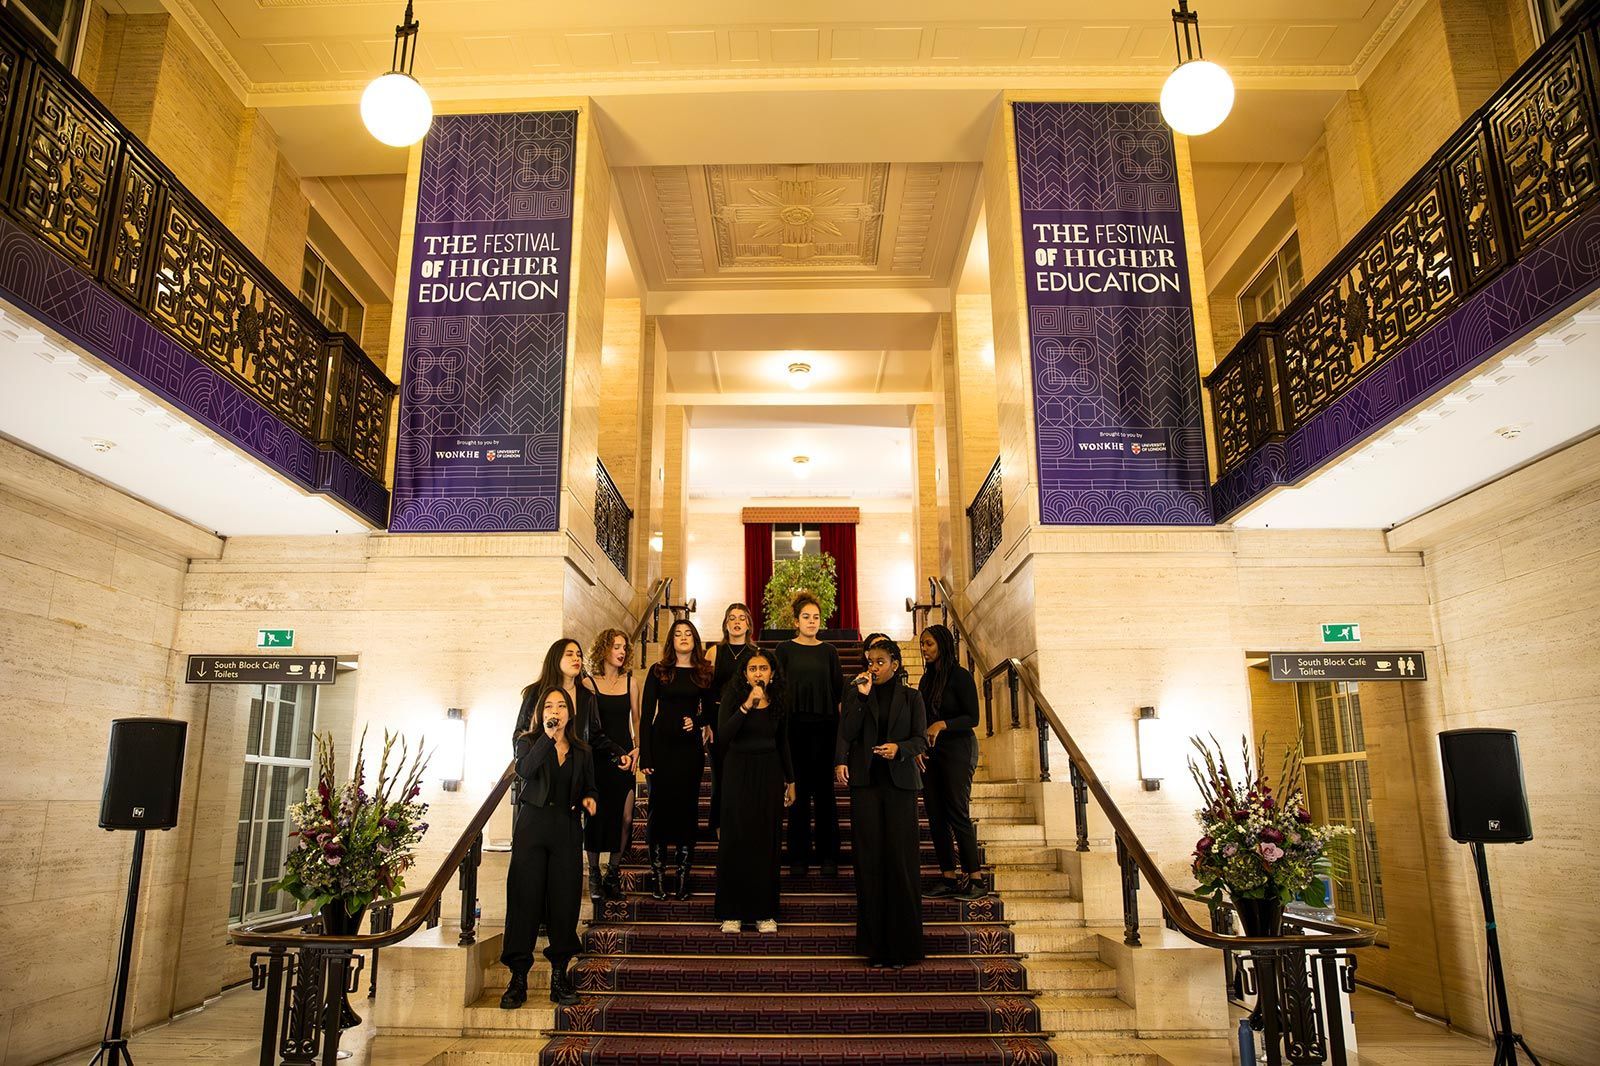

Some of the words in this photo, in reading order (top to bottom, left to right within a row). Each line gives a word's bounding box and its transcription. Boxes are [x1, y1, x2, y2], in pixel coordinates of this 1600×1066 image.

[424, 234, 477, 256] THE
[484, 232, 560, 254] FESTIVAL
[1032, 224, 1090, 244] THE
[1095, 224, 1175, 244] FESTIVAL
[420, 260, 444, 278] OF
[448, 256, 559, 278] HIGHER
[1034, 248, 1058, 267] OF
[1063, 248, 1178, 268] HIGHER
[418, 280, 558, 303] EDUCATION
[1036, 272, 1180, 293] EDUCATION
[1078, 442, 1124, 451] WONKHE
[214, 661, 237, 669] South
[239, 661, 260, 669] Block
[262, 661, 280, 669] Café
[1298, 658, 1322, 666] South
[1324, 658, 1346, 666] Block
[1348, 657, 1367, 666] Café
[214, 670, 238, 678] Toilets
[1299, 668, 1325, 676] Toilets
